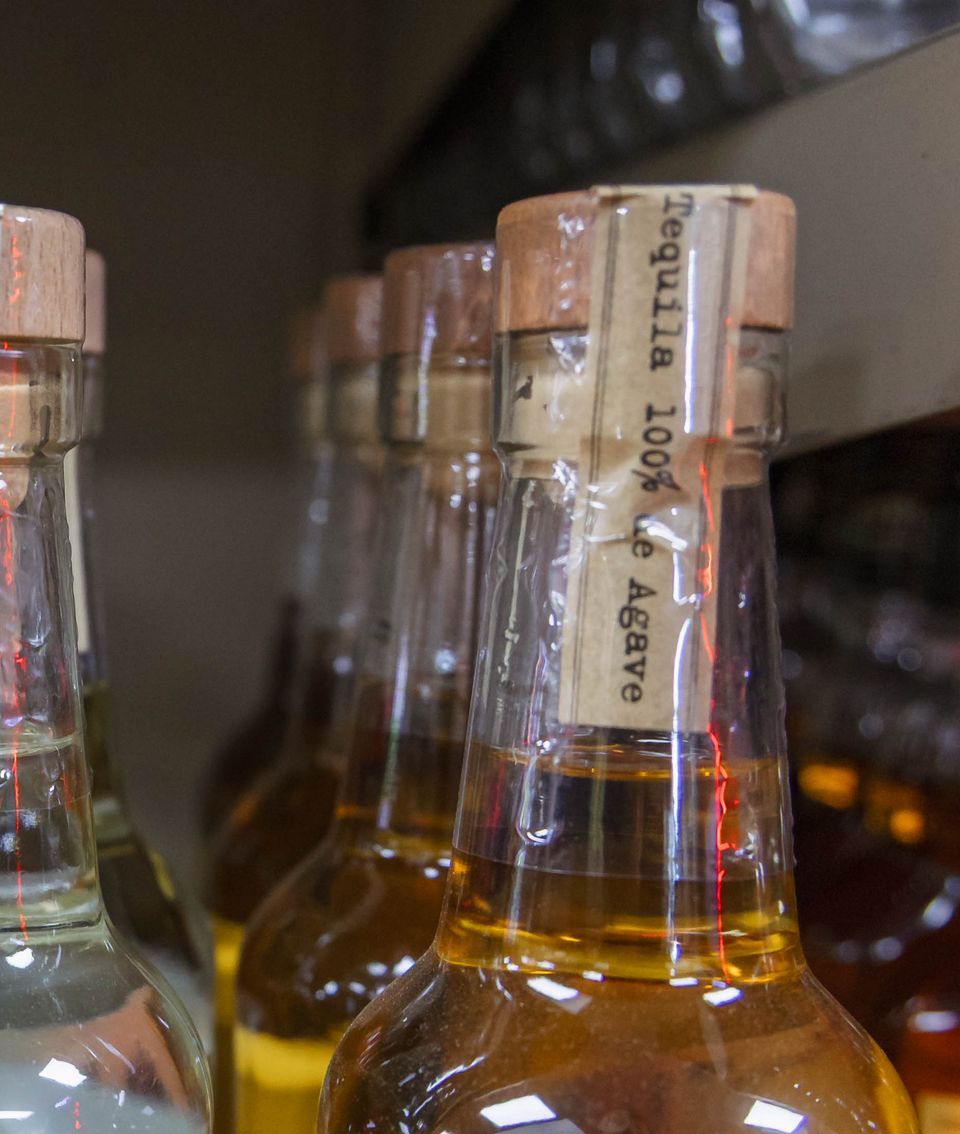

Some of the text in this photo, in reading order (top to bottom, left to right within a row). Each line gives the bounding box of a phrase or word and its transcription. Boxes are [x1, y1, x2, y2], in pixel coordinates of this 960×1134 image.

[648, 193, 695, 372] Tequila
[632, 403, 681, 491] 100%
[619, 576, 657, 703] Agave
